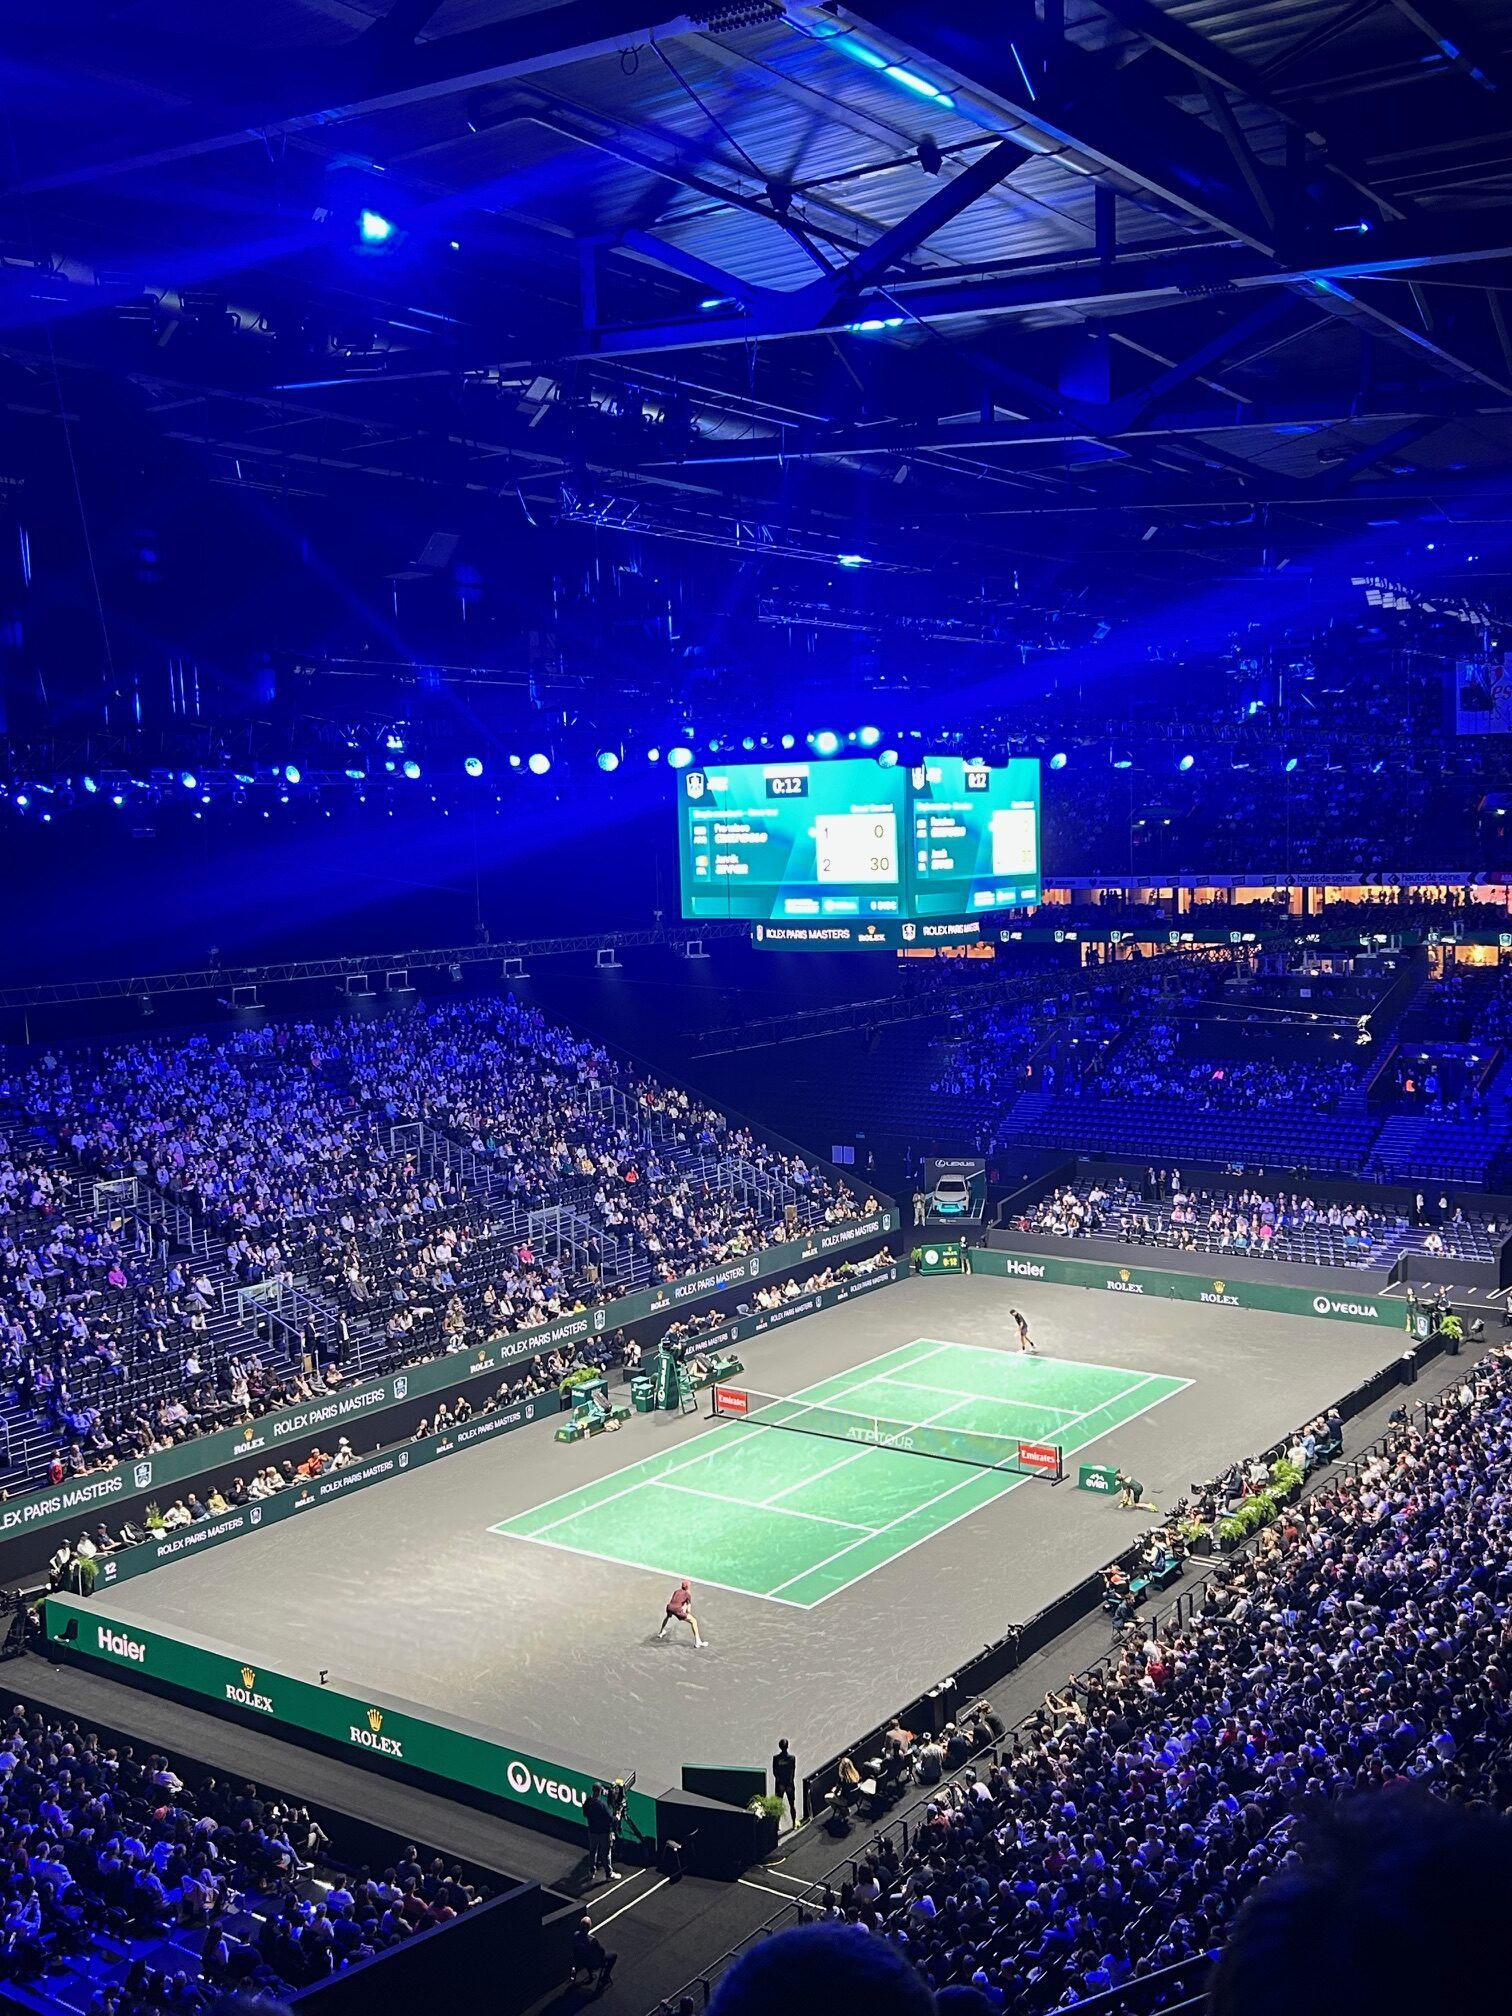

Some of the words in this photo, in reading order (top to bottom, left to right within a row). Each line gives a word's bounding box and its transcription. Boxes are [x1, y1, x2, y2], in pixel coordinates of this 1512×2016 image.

[772, 778, 802, 794] 0:12
[824, 827, 829, 839] 1
[874, 824, 884, 839] 0
[823, 858, 831, 872] 2
[870, 857, 890, 871] 30
[766, 929, 786, 939] ROLEX
[786, 929, 808, 939] PARIS
[808, 929, 851, 940] MASTERS
[821, 1234, 840, 1248] ROLEX
[840, 1228, 855, 1243] PARIS
[854, 1221, 879, 1238] MASTERS
[1007, 1259, 1045, 1277] Haier
[674, 1283, 697, 1299] ROLEX
[697, 1276, 716, 1292] PARIS
[715, 1266, 745, 1285] MASTERS
[1106, 1280, 1144, 1294] ROLEX
[1200, 1292, 1240, 1307] ROLEX
[1331, 1301, 1379, 1318] VEOLIA
[501, 1341, 528, 1359] ROLEX
[528, 1332, 551, 1350] PARIS
[551, 1320, 588, 1343] MASTERS
[718, 1394, 747, 1408] Emirates
[273, 1414, 308, 1437] ROLEX
[309, 1405, 338, 1426] PARIS
[339, 1388, 385, 1415] MASTERS
[457, 1428, 478, 1443] ROLEX
[477, 1421, 495, 1436] PARIS
[494, 1411, 522, 1429] MASTERS
[233, 1437, 266, 1455] ROLEX
[847, 1426, 875, 1441] ATP
[877, 1432, 914, 1449] TOUR
[1020, 1448, 1057, 1465] Emirates
[320, 1479, 343, 1496] ROLEX
[342, 1472, 363, 1487] PARIS
[362, 1460, 394, 1479] MASTERS
[1085, 1478, 1109, 1490] evian
[24, 1496, 61, 1521] PARIS
[62, 1476, 123, 1508] MASTERS
[157, 1539, 185, 1558] ROLEX
[184, 1531, 208, 1549] PARIS
[207, 1516, 244, 1539] MASTERS
[97, 1626, 146, 1663] Haier
[225, 1684, 274, 1713] ROLEX
[349, 1726, 403, 1758] ROLEX
